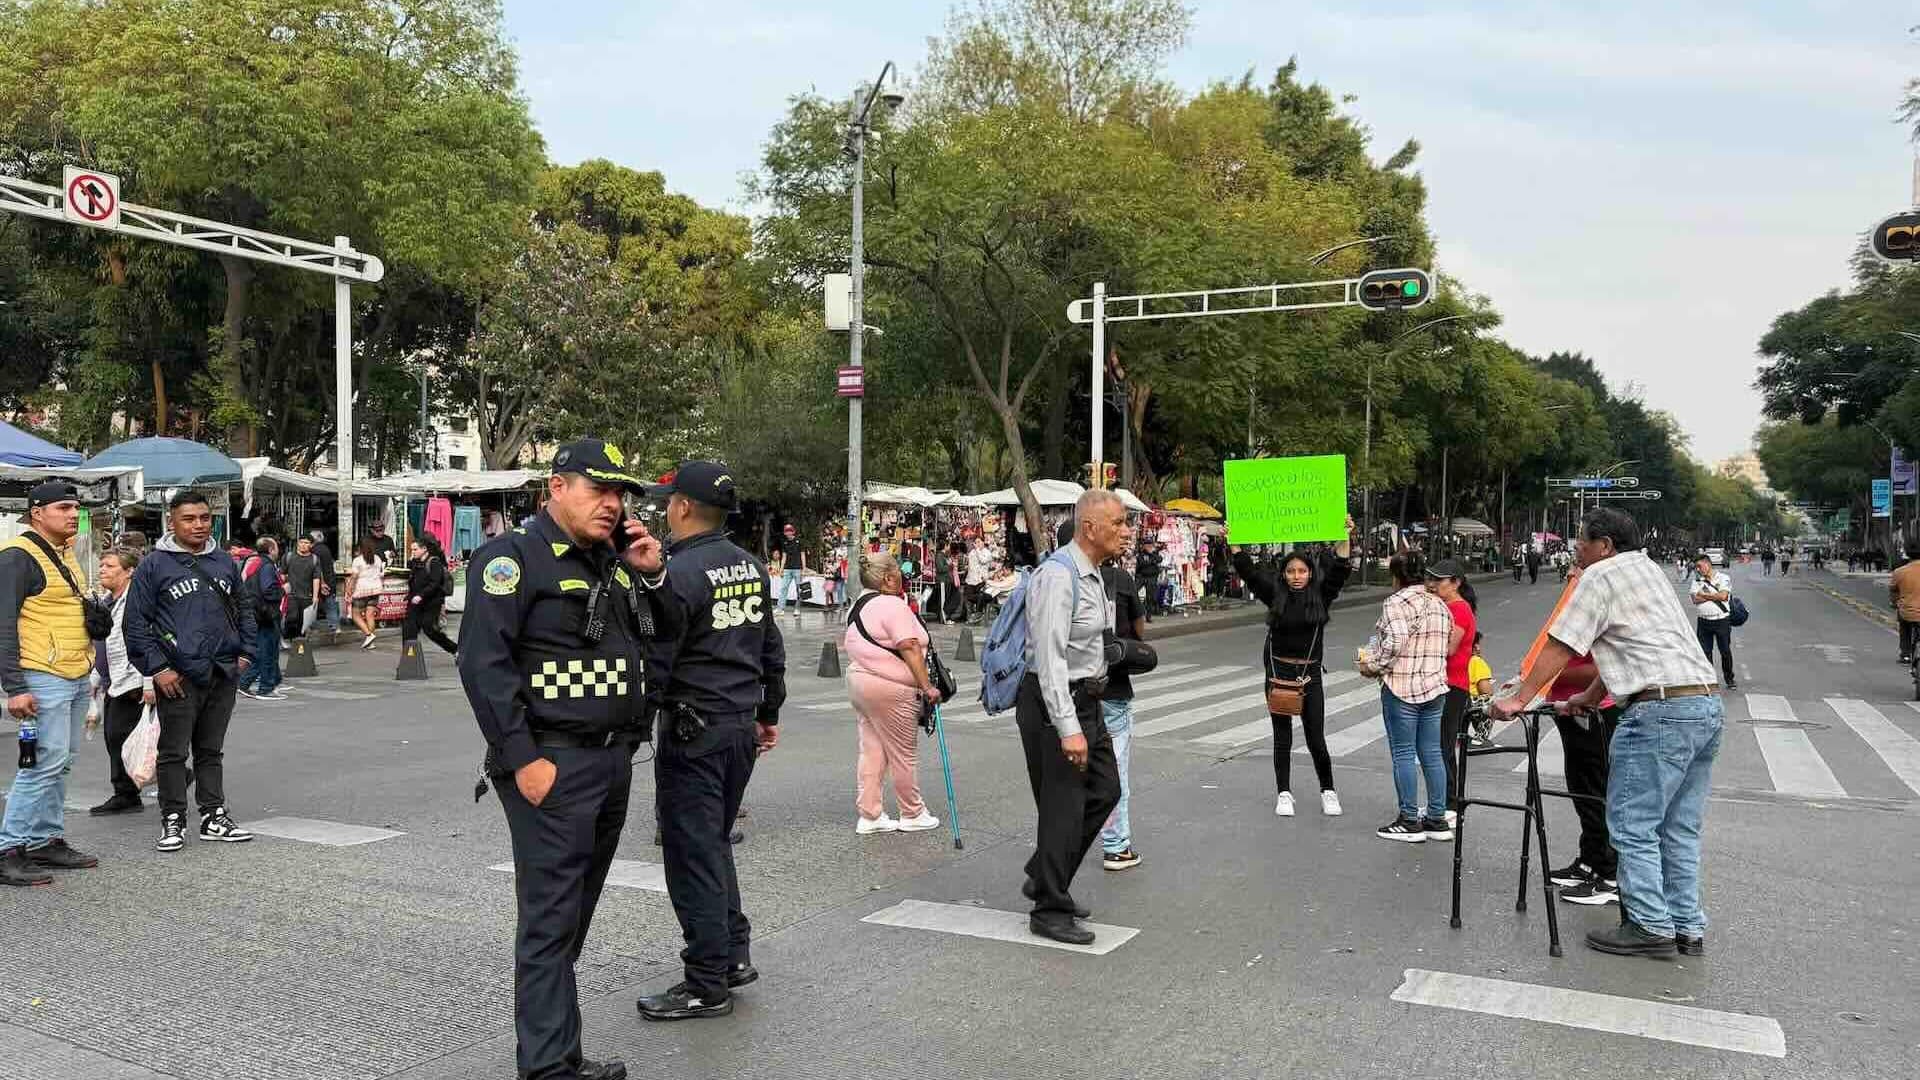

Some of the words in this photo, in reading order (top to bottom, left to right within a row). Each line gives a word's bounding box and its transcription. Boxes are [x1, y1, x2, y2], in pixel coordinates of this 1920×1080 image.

[705, 560, 760, 586] POLICÍA
[168, 578, 200, 600] HUF
[712, 595, 764, 629] SSC
